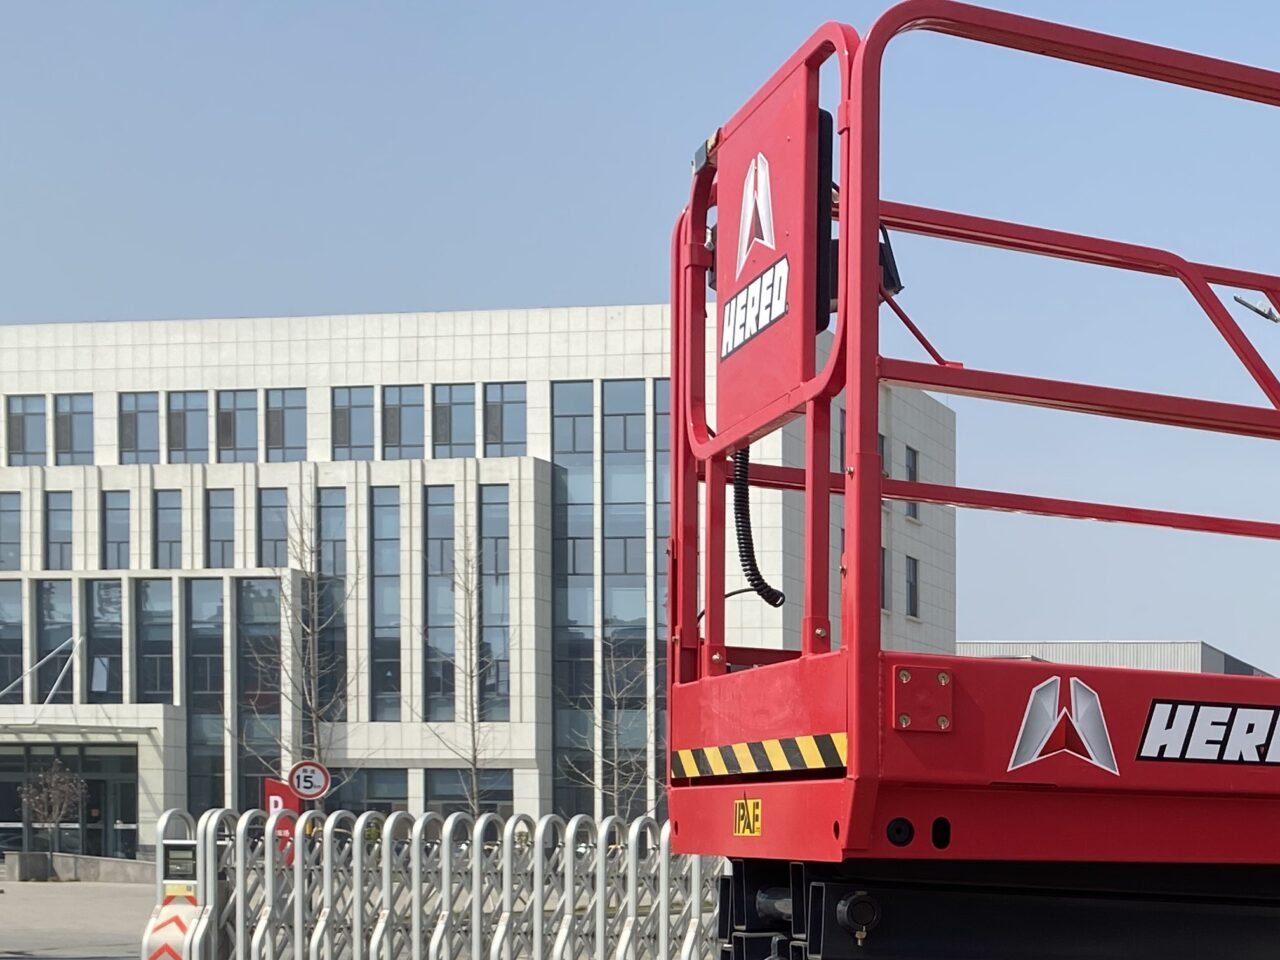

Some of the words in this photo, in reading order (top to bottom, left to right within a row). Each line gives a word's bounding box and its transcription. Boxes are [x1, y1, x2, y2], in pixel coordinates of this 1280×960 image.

[721, 254, 788, 359] HERED
[296, 774, 314, 790] 15
[734, 790, 760, 834] IPAF
